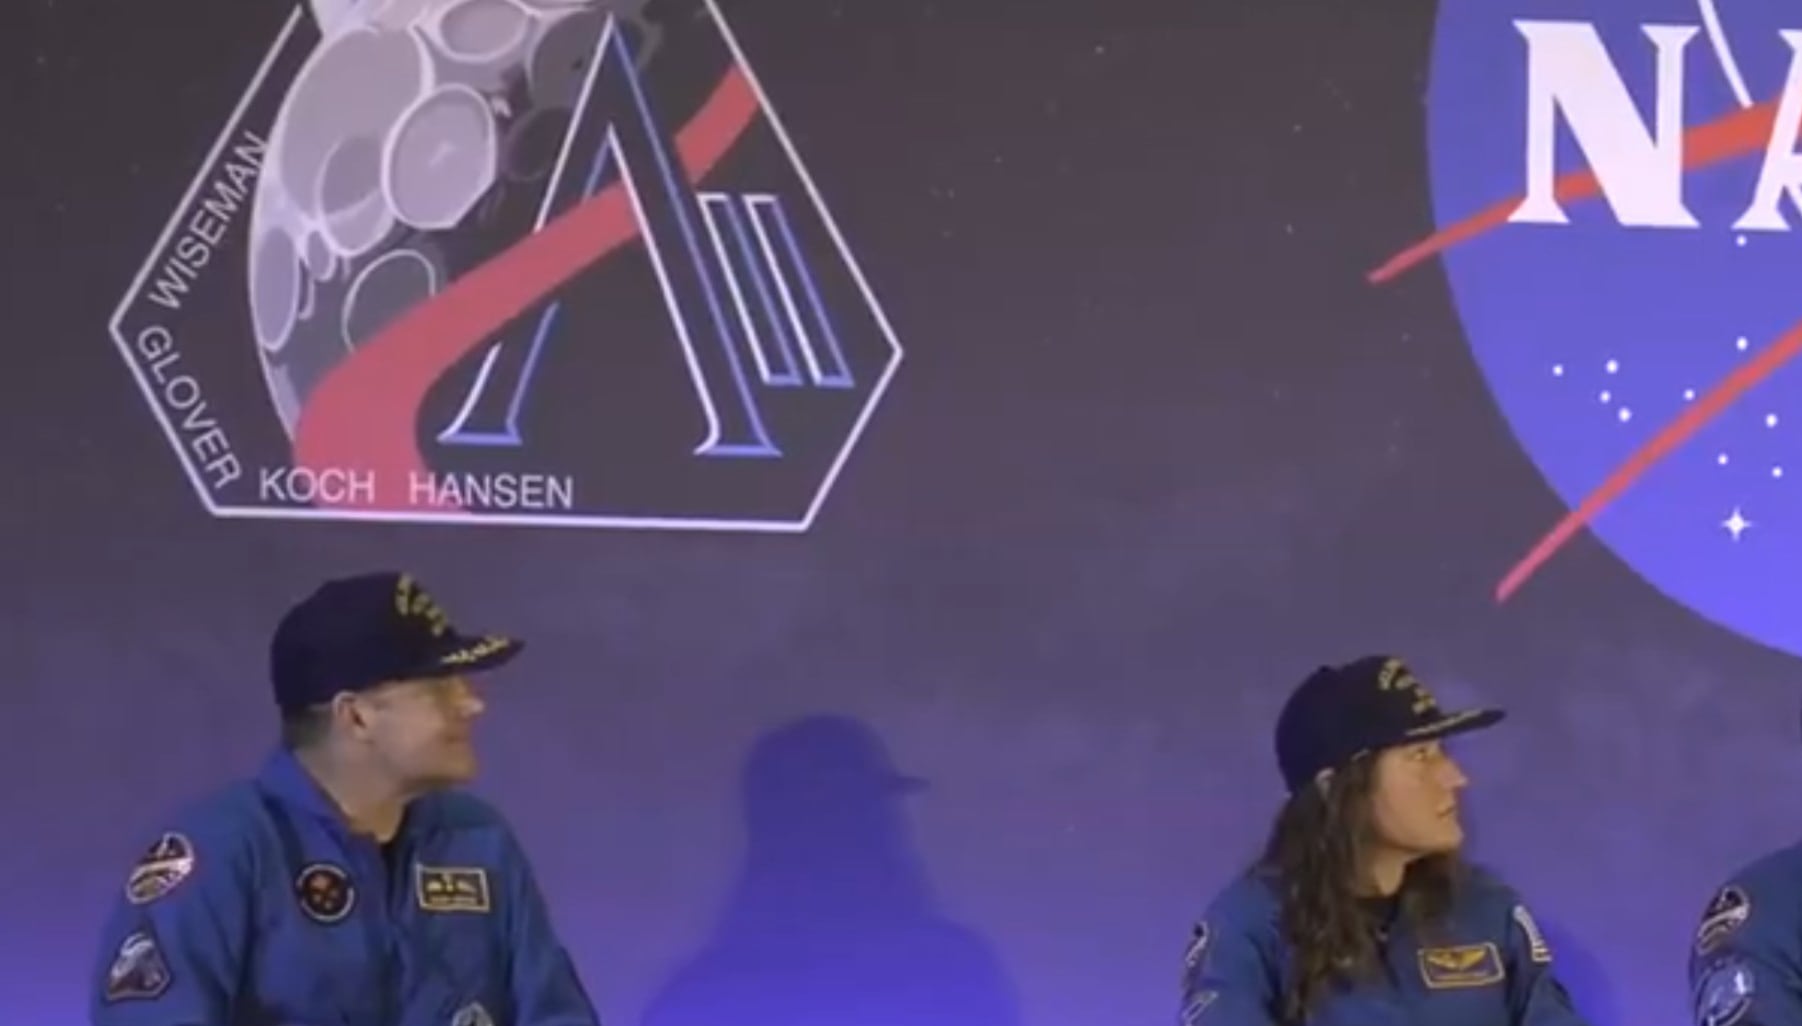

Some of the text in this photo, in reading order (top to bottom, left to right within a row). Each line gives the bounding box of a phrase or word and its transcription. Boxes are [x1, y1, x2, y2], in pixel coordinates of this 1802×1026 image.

[148, 130, 268, 309] WISEMAN
[137, 325, 242, 490] GLOVER
[259, 467, 573, 510] KOCH HANSEN
